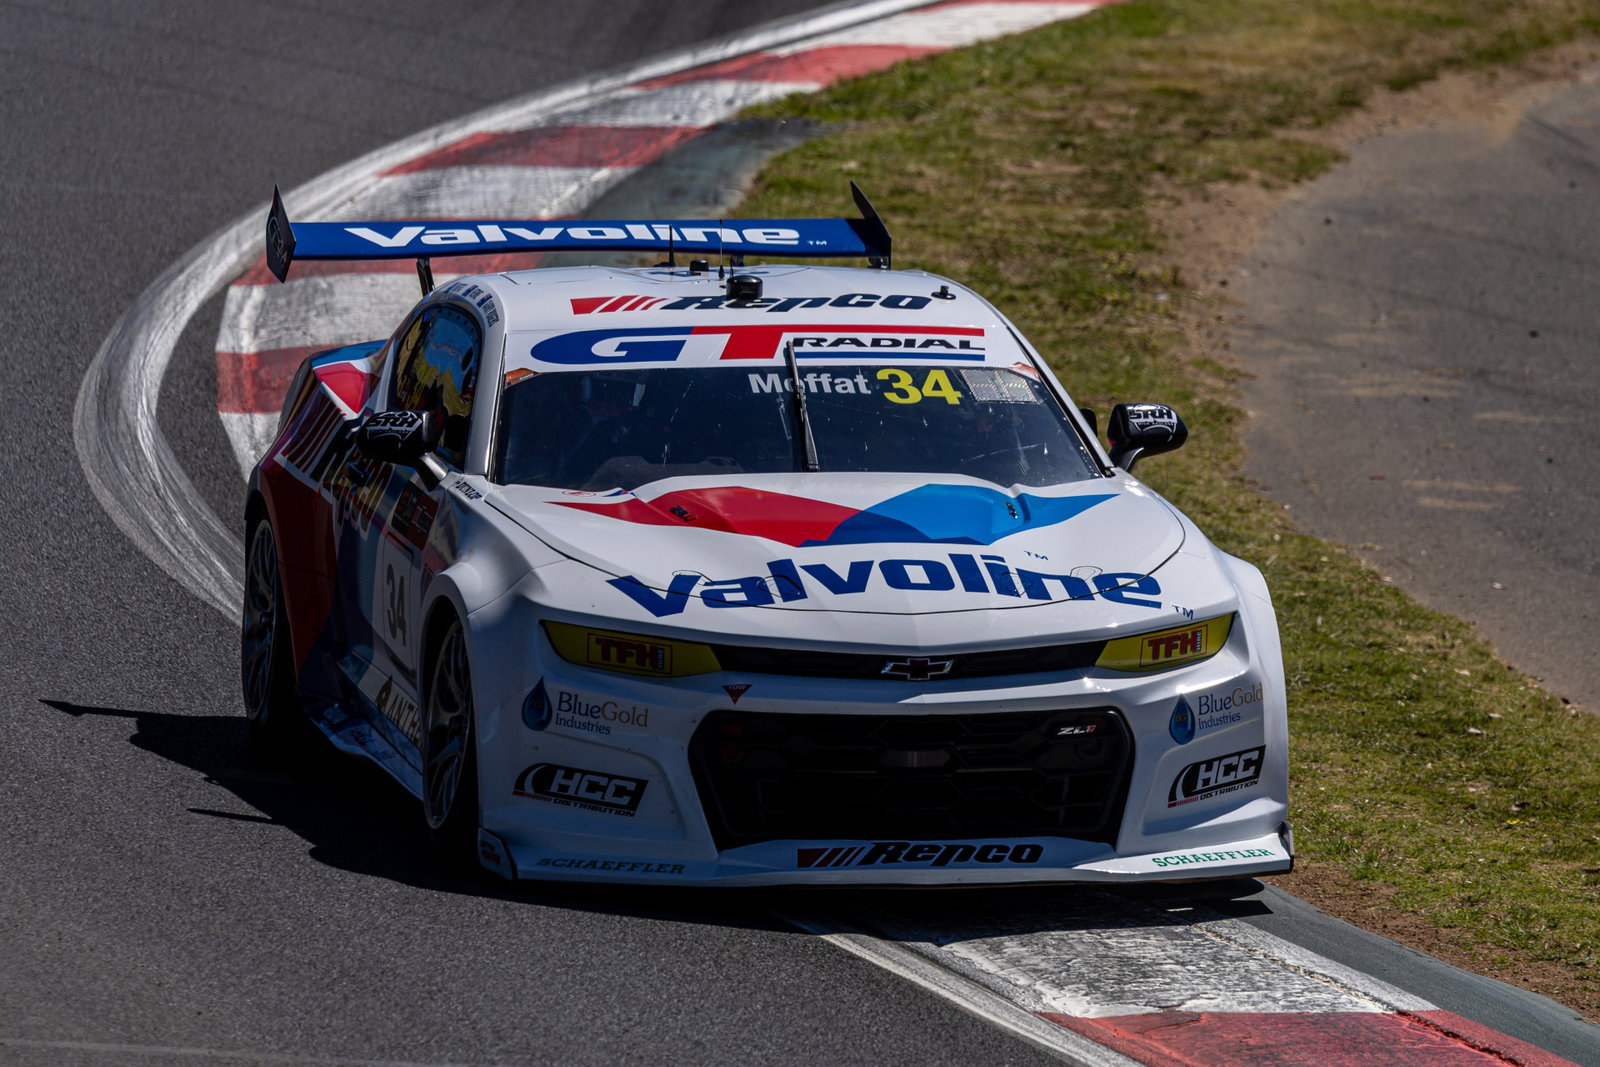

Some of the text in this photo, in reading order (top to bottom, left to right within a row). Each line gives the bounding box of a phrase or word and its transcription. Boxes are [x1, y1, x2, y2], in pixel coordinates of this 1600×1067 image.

[344, 223, 801, 248] Valvoline
[659, 293, 933, 313] Repco
[530, 326, 986, 365] GT RADIAL
[748, 368, 962, 406] Moffat 34
[606, 557, 1163, 617] Valvoline
[386, 563, 407, 648] 34
[595, 637, 658, 670] TFH
[1149, 631, 1197, 659] TFH
[556, 691, 650, 728] BlueGold
[1198, 682, 1264, 716] BlueGold
[555, 713, 611, 735] Industries
[1198, 711, 1241, 731] Industries
[1197, 751, 1259, 787] HCC
[549, 769, 636, 805] HCC
[1199, 779, 1260, 801] DISTRIBUTION
[553, 797, 636, 818] DISTRIBUTION
[536, 857, 686, 875] SCHAEFFLER
[859, 841, 1043, 867] Repco
[1151, 848, 1276, 868] SCHAEFFLER
